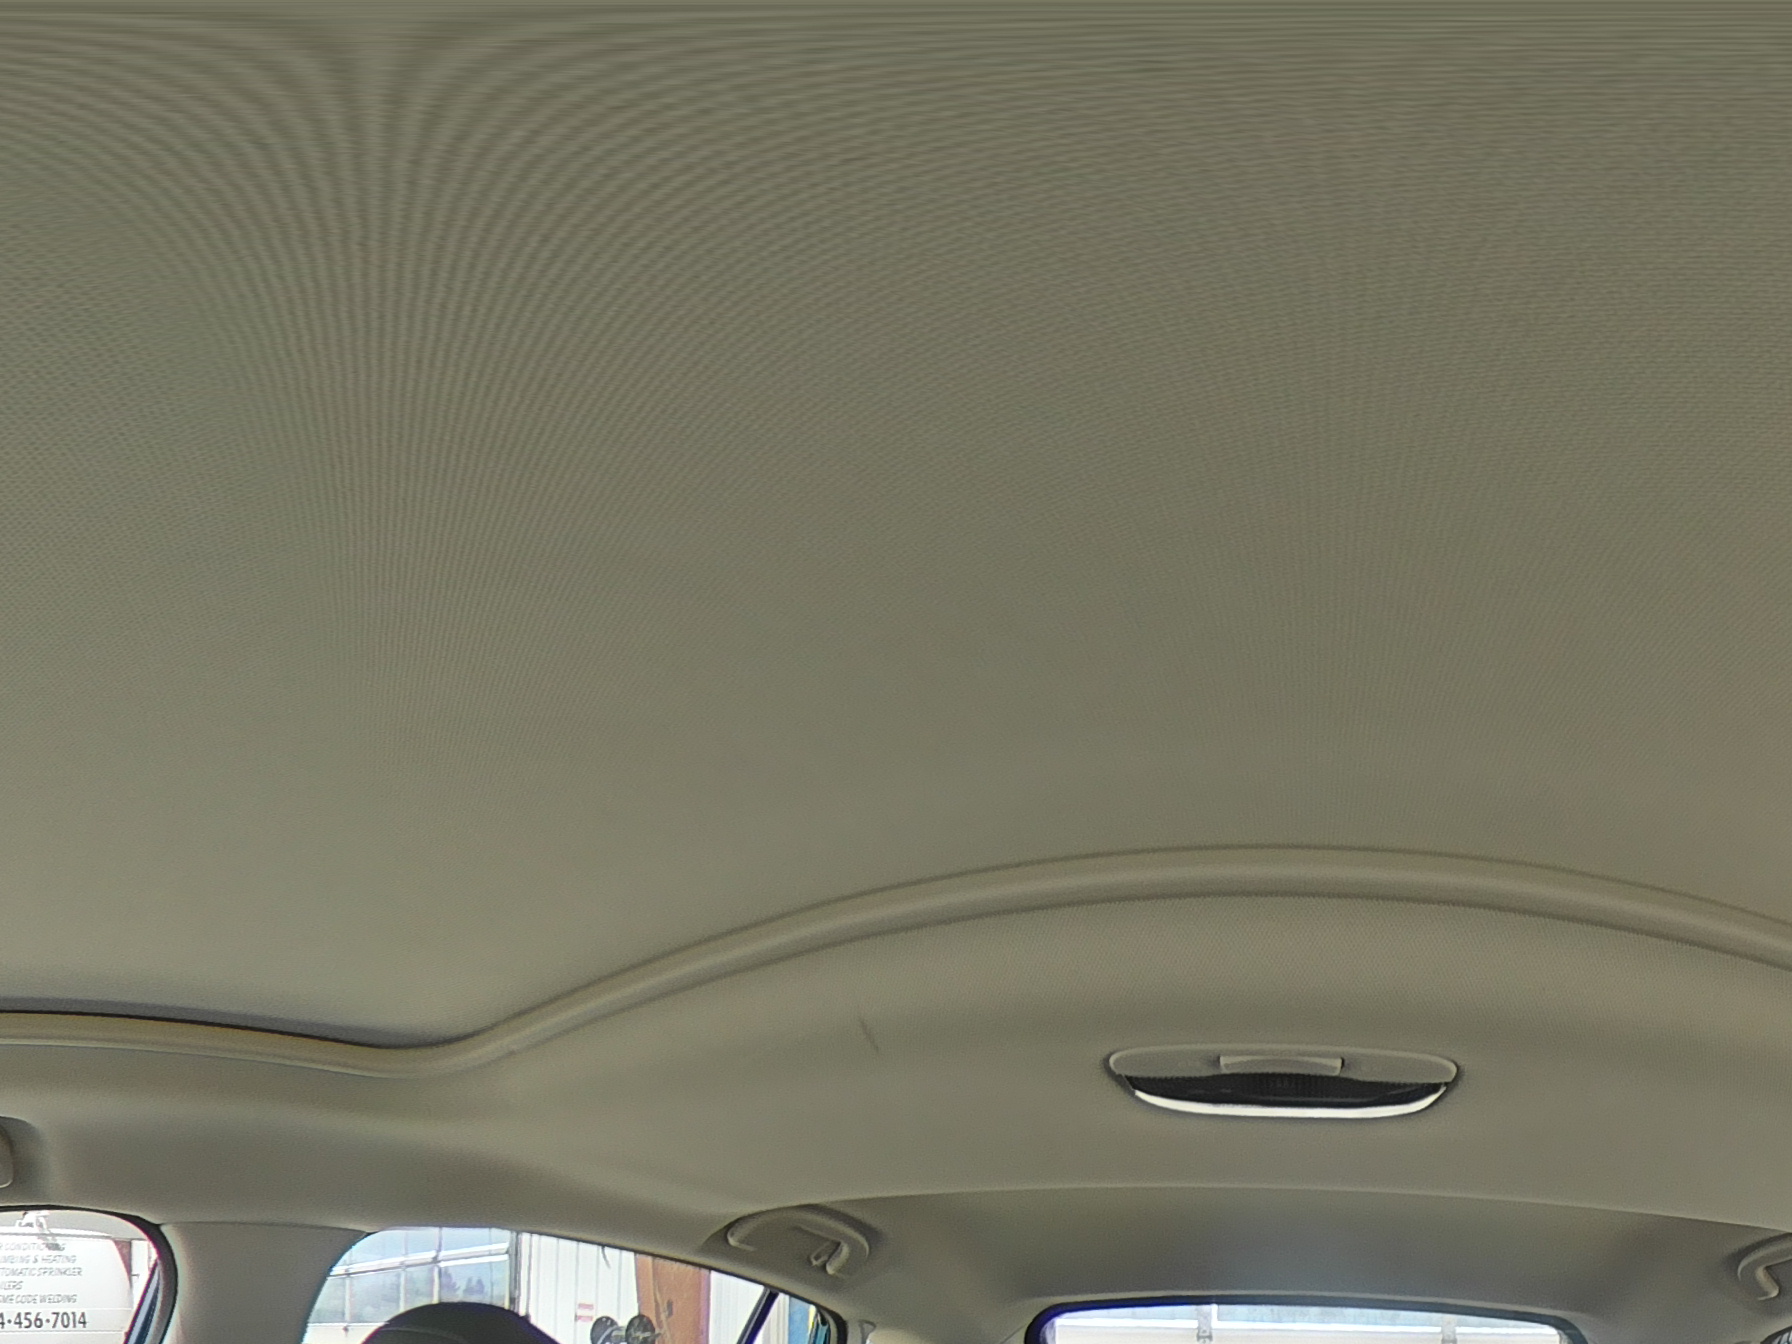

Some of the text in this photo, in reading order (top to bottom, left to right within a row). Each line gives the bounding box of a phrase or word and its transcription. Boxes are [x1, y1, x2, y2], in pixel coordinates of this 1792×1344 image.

[41, 1255, 77, 1263] HEATING
[16, 1294, 38, 1304] CODE
[39, 1294, 77, 1304] WELDING
